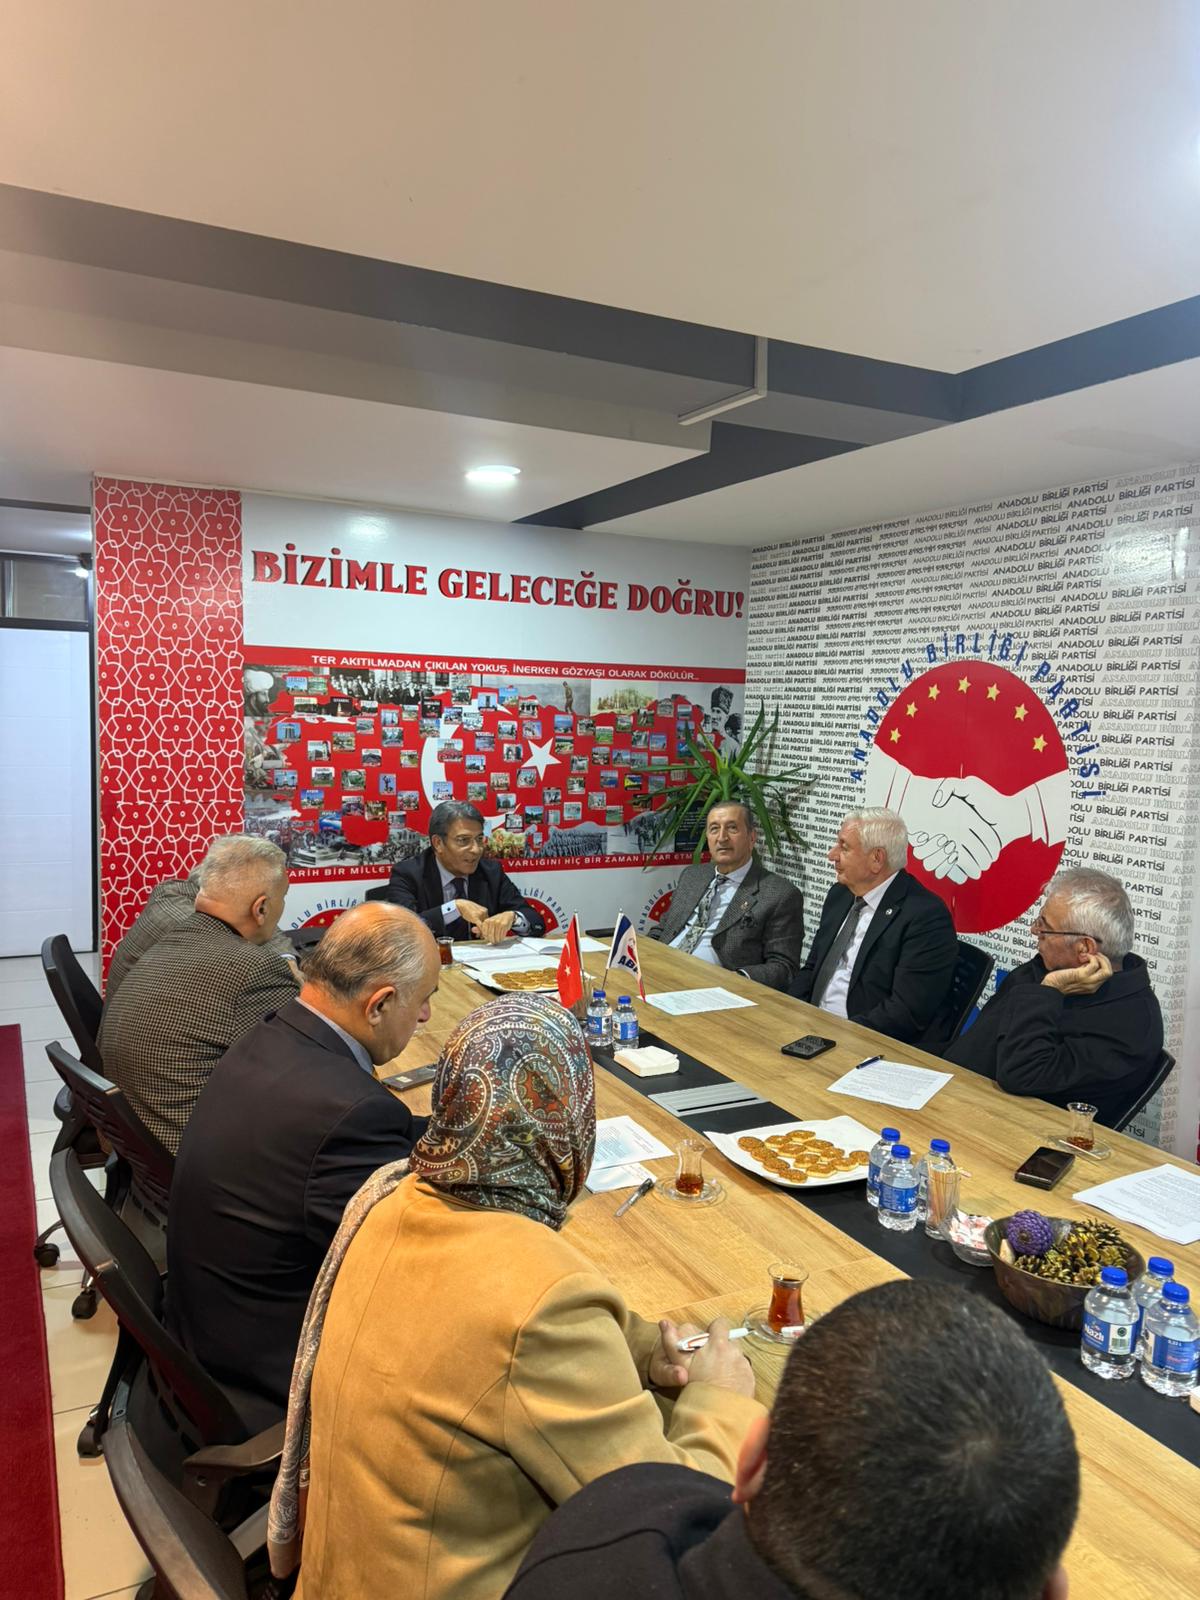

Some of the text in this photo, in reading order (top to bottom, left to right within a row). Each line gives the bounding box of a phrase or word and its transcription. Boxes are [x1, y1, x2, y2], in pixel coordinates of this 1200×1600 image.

[997, 480, 1109, 510] ANADOLU BİRLİĞİ PARTİSİ
[1067, 477, 1196, 509] ANADOLU BİRLİĞİ PARTİSİ
[995, 505, 1107, 532] ANADOLU BİRLİĞİ PARTİSİ
[1065, 504, 1194, 532] ANADOLU BİRLİĞİ PARTİSİ
[994, 531, 1105, 554] ANADOLU BİRLİĞİ PARTİSİ
[993, 555, 1104, 576] ANADOLU BİRLİĞİ PARTİSİ
[252, 543, 744, 618] BİZİMLE GELECEĞE DOĞRU!
[991, 579, 1102, 597] ANADOLU BİRLİĞİ PARTİSİ
[1060, 583, 1187, 603] ANADOLU BİRLİĞİ PARTİSİ
[990, 602, 1100, 619] ANADOLU BİRLİĞİ PARTİSİ
[1059, 608, 1185, 626] ANADOLU BİRLİĞİ PARTİSİ
[1033, 627, 1060, 638] BİRLİĞİ
[1063, 626, 1098, 637] PARTİSİ
[1057, 634, 1183, 649] ANADOLU BİRLİĞİ PARTİSİ
[1031, 649, 1096, 661] BİRLİĞİ PARTİSİ
[311, 655, 336, 664] TER
[340, 657, 421, 669] AKITILMADAN
[425, 660, 467, 672] ÇIKILAN
[513, 663, 558, 675] İNERKEN
[562, 665, 605, 678] GÖZYAŞI
[608, 669, 647, 678] OLARAK
[1056, 660, 1181, 672] ANADOLU BİRLİĞİ PARTİSİ
[1056, 685, 1179, 696] NADOLU BİRLİĞİ PARTİSİ
[850, 629, 1106, 799] ANADOLU BİRLİĞİ PARTİSİ
[1103, 709, 1134, 720] BİRLİĞİ
[1138, 710, 1177, 721] PARTİSİ
[1102, 733, 1133, 744] BİRLİĞİ
[1136, 735, 1175, 746] PARTİSİ
[1100, 758, 1131, 769] BİRLİĞİ
[1134, 760, 1173, 772] PARTİSİ
[1098, 781, 1129, 793] BİRLİĞİ
[1132, 785, 1171, 797] PARTİSİ
[1096, 805, 1169, 822] BİRLİĞİ PARTİSİ
[1094, 829, 1167, 847] BİRLİĞİ PARTİSİ
[564, 856, 581, 865] HİÇ
[585, 856, 601, 864] BİR
[605, 855, 639, 863] ZAMAN
[1063, 848, 1166, 871] DOLU BİRLİĞİ PARTİSİ
[287, 868, 319, 877] ARİH
[324, 867, 345, 876] BİR
[1125, 881, 1164, 896] PARTİSİ
[316, 897, 357, 911] BİRLİĞ
[1132, 907, 1161, 921] ARTİSİ
[1134, 932, 1159, 945] RTİSİ
